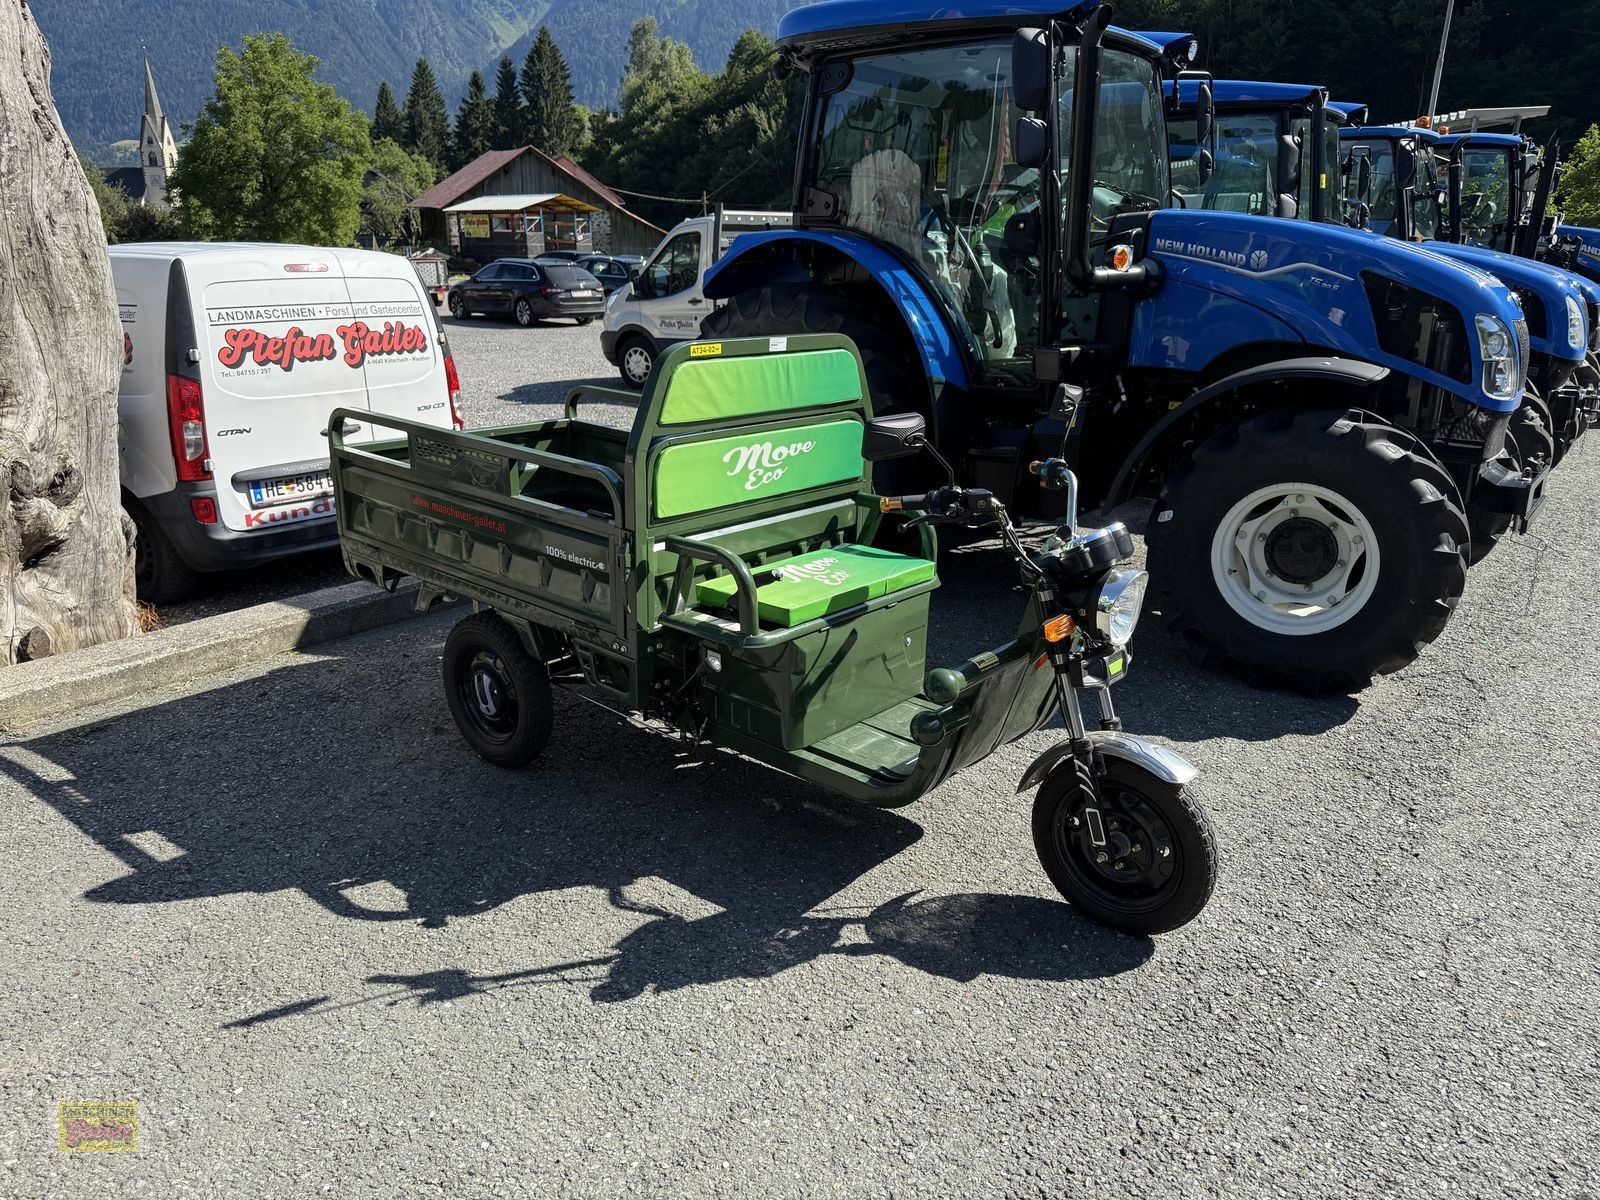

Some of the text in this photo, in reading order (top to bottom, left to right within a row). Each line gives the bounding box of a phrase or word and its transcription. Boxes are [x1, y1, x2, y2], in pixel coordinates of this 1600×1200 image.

[1155, 238, 1246, 267] NEW HOLLAND
[208, 307, 316, 322] LANDMASCHINEN
[325, 306, 350, 316] Forst
[370, 305, 420, 315] Gartencenter
[218, 321, 427, 372] Stefan Gailer
[217, 427, 251, 437] CITAN
[722, 440, 816, 476] Move
[265, 480, 285, 498] HE
[295, 474, 323, 492] 584
[744, 466, 787, 491] Eco
[411, 495, 507, 533] www.maschinen-gailer.at
[545, 545, 597, 569] 100% electric
[779, 556, 838, 583] Move
[814, 570, 850, 585] Eco
